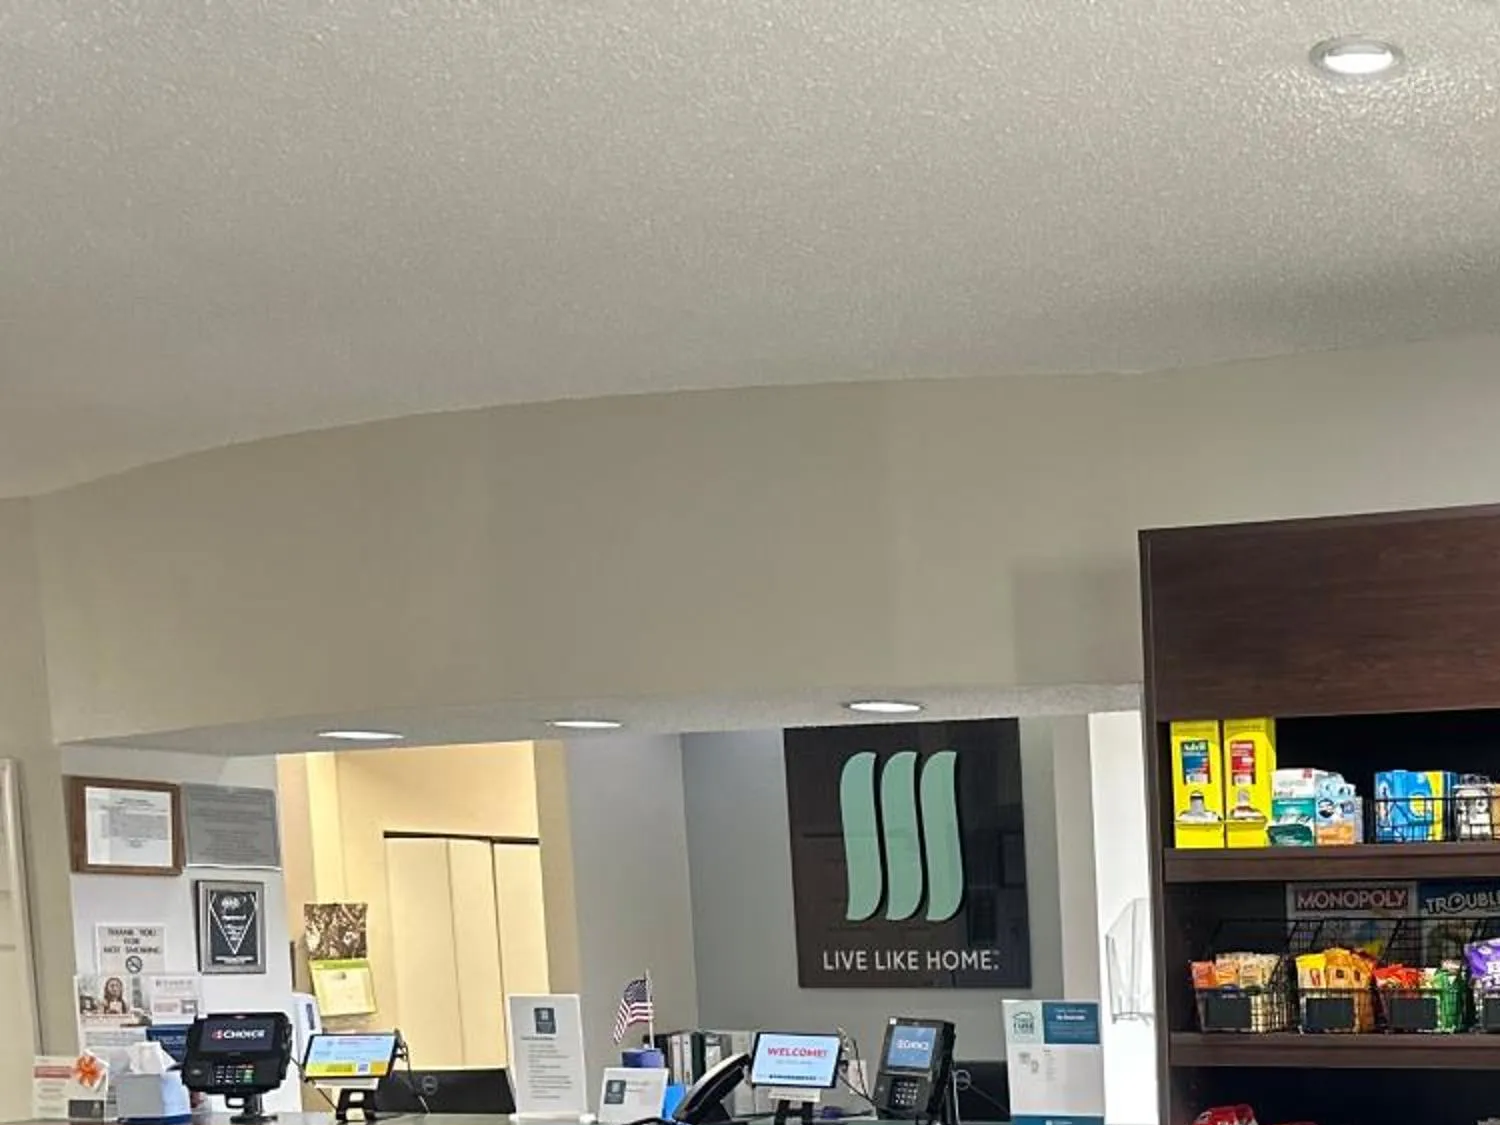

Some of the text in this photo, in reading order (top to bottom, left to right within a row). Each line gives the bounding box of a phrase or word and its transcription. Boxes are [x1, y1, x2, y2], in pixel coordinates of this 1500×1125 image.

[1297, 889, 1409, 912] MONOPOLY
[823, 950, 868, 970] LIVE
[875, 950, 919, 970] LIKE
[223, 1029, 265, 1039] CHOICE
[767, 1046, 828, 1058] WELCOME!
